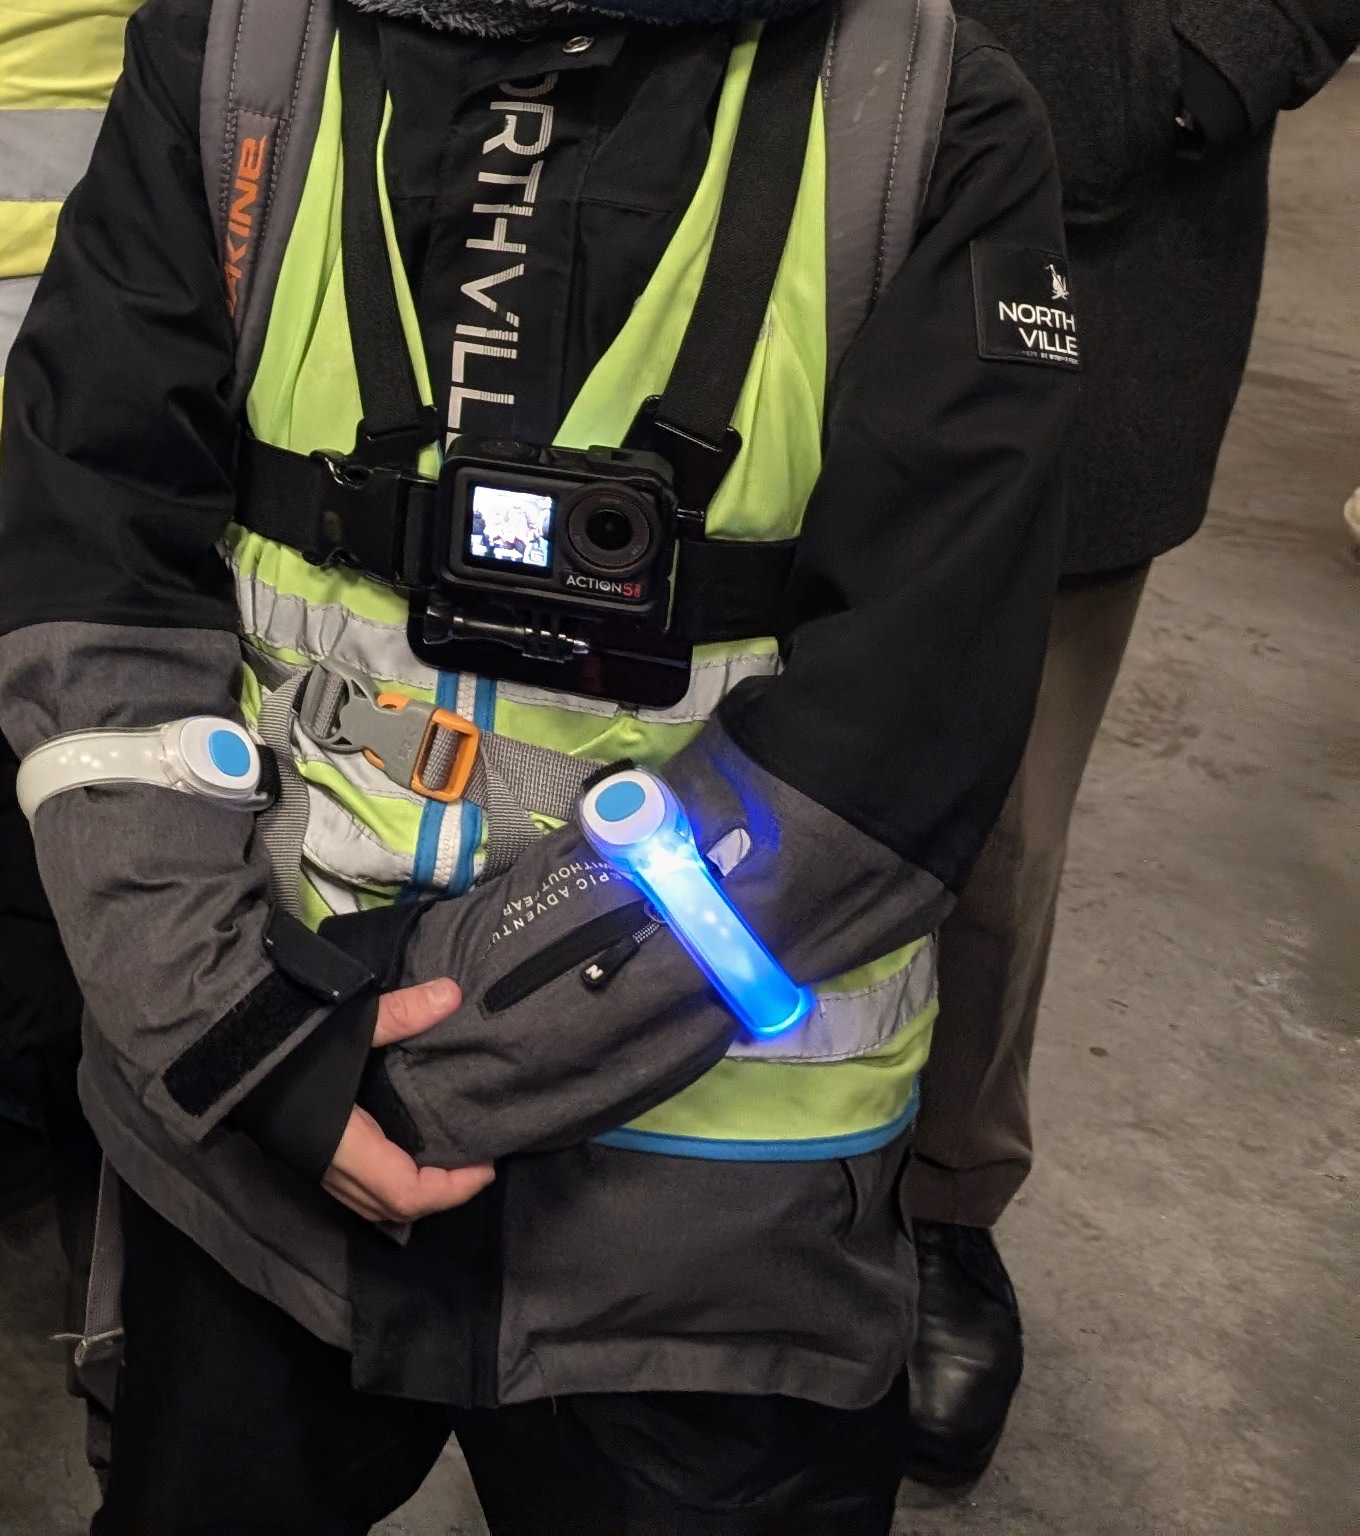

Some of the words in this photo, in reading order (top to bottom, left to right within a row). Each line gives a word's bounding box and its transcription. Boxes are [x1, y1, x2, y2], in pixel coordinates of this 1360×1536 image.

[223, 134, 269, 316] AKINE
[998, 300, 1076, 332] NORTH
[1018, 327, 1079, 356] VILLE
